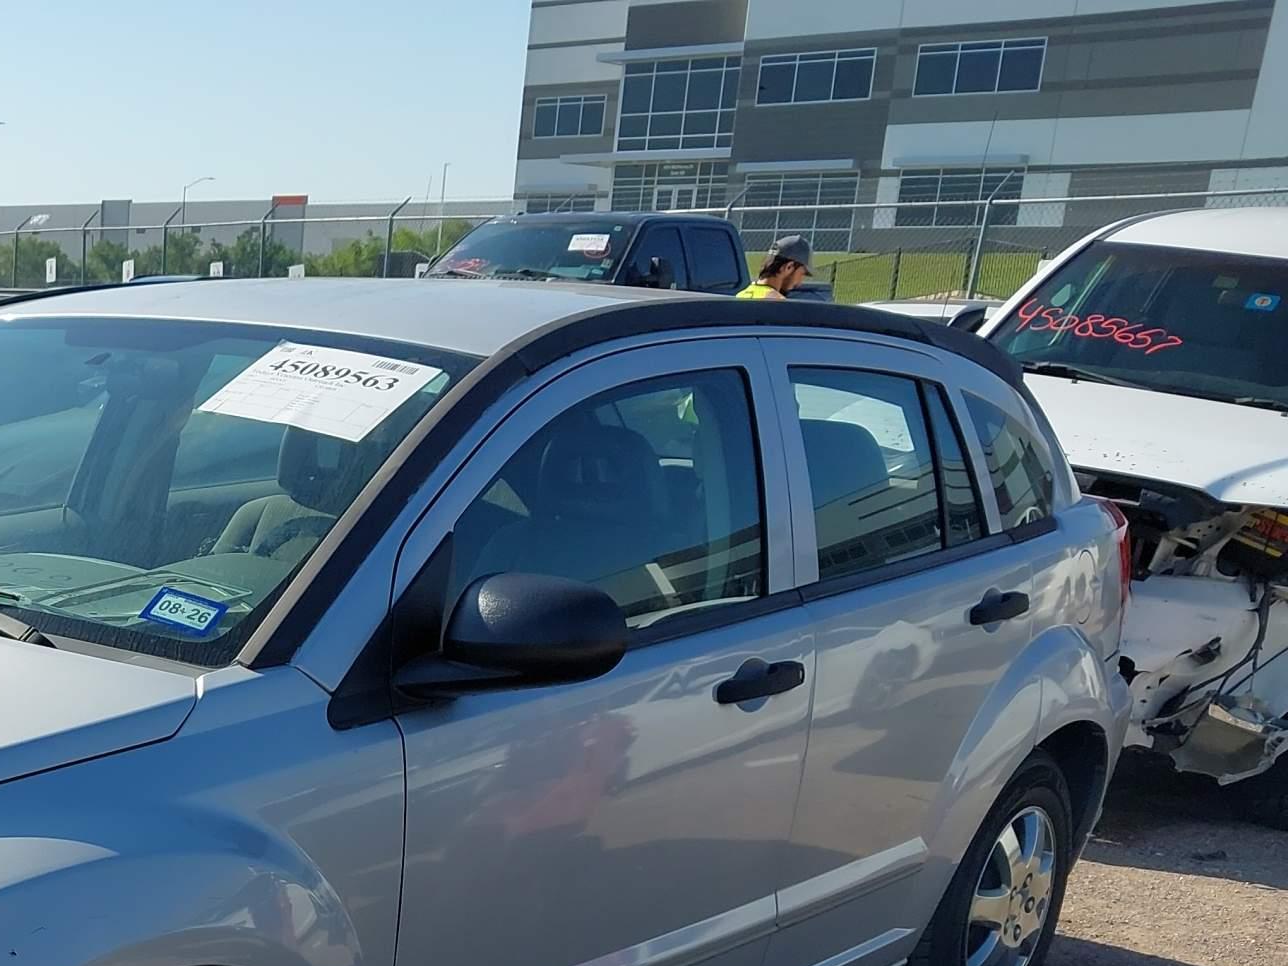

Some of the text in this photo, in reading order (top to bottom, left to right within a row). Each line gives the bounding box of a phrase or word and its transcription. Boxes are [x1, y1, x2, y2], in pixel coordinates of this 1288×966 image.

[1016, 298, 1183, 355] 45085657
[268, 358, 401, 393] 45089563
[158, 599, 211, 623] 08 26
